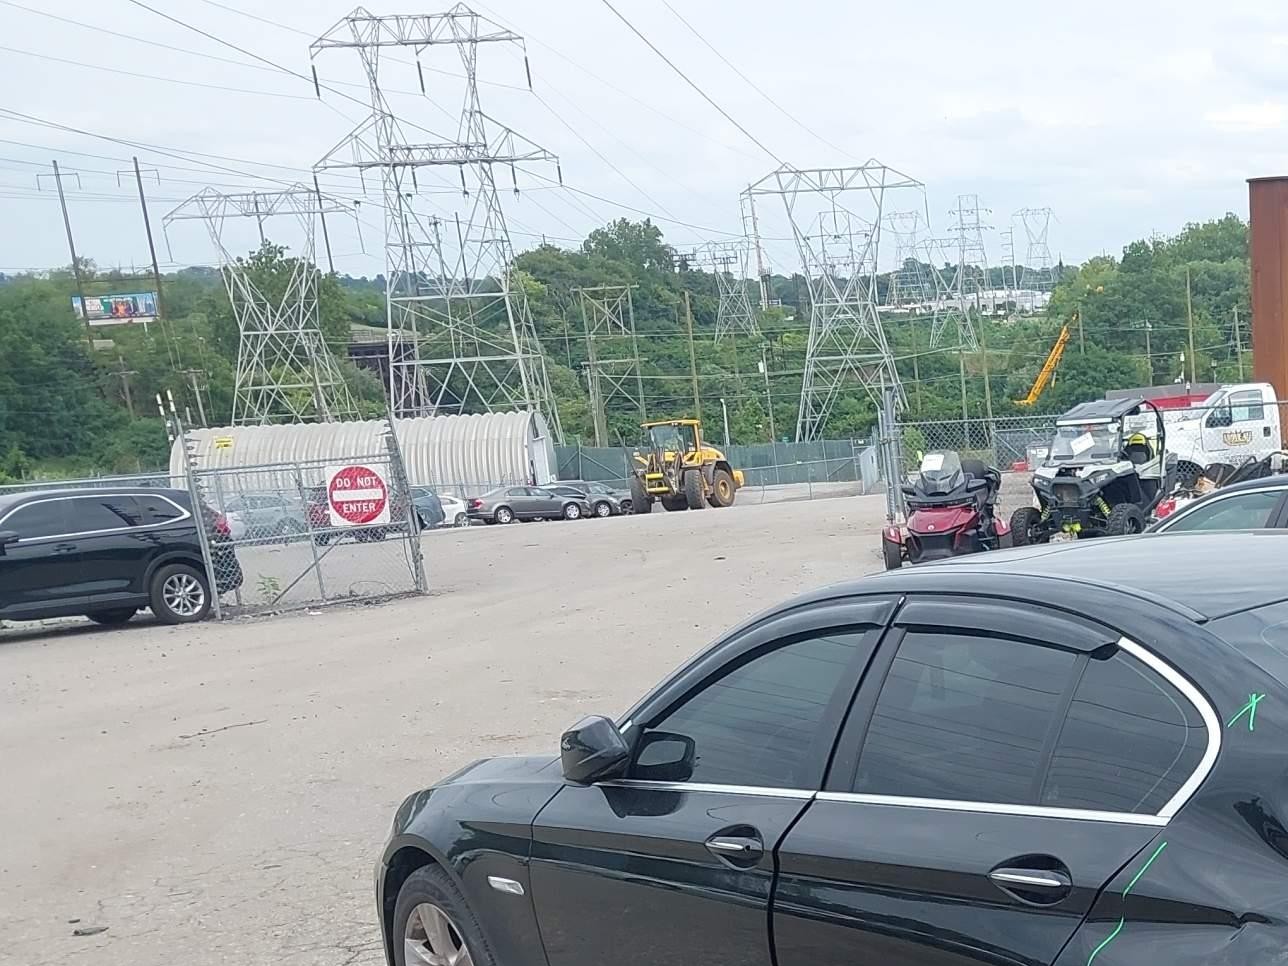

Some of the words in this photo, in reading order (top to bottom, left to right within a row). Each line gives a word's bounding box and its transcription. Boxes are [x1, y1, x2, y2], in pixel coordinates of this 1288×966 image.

[336, 477, 351, 488] DO
[357, 476, 377, 488] NOT
[343, 502, 376, 513] ENTER
